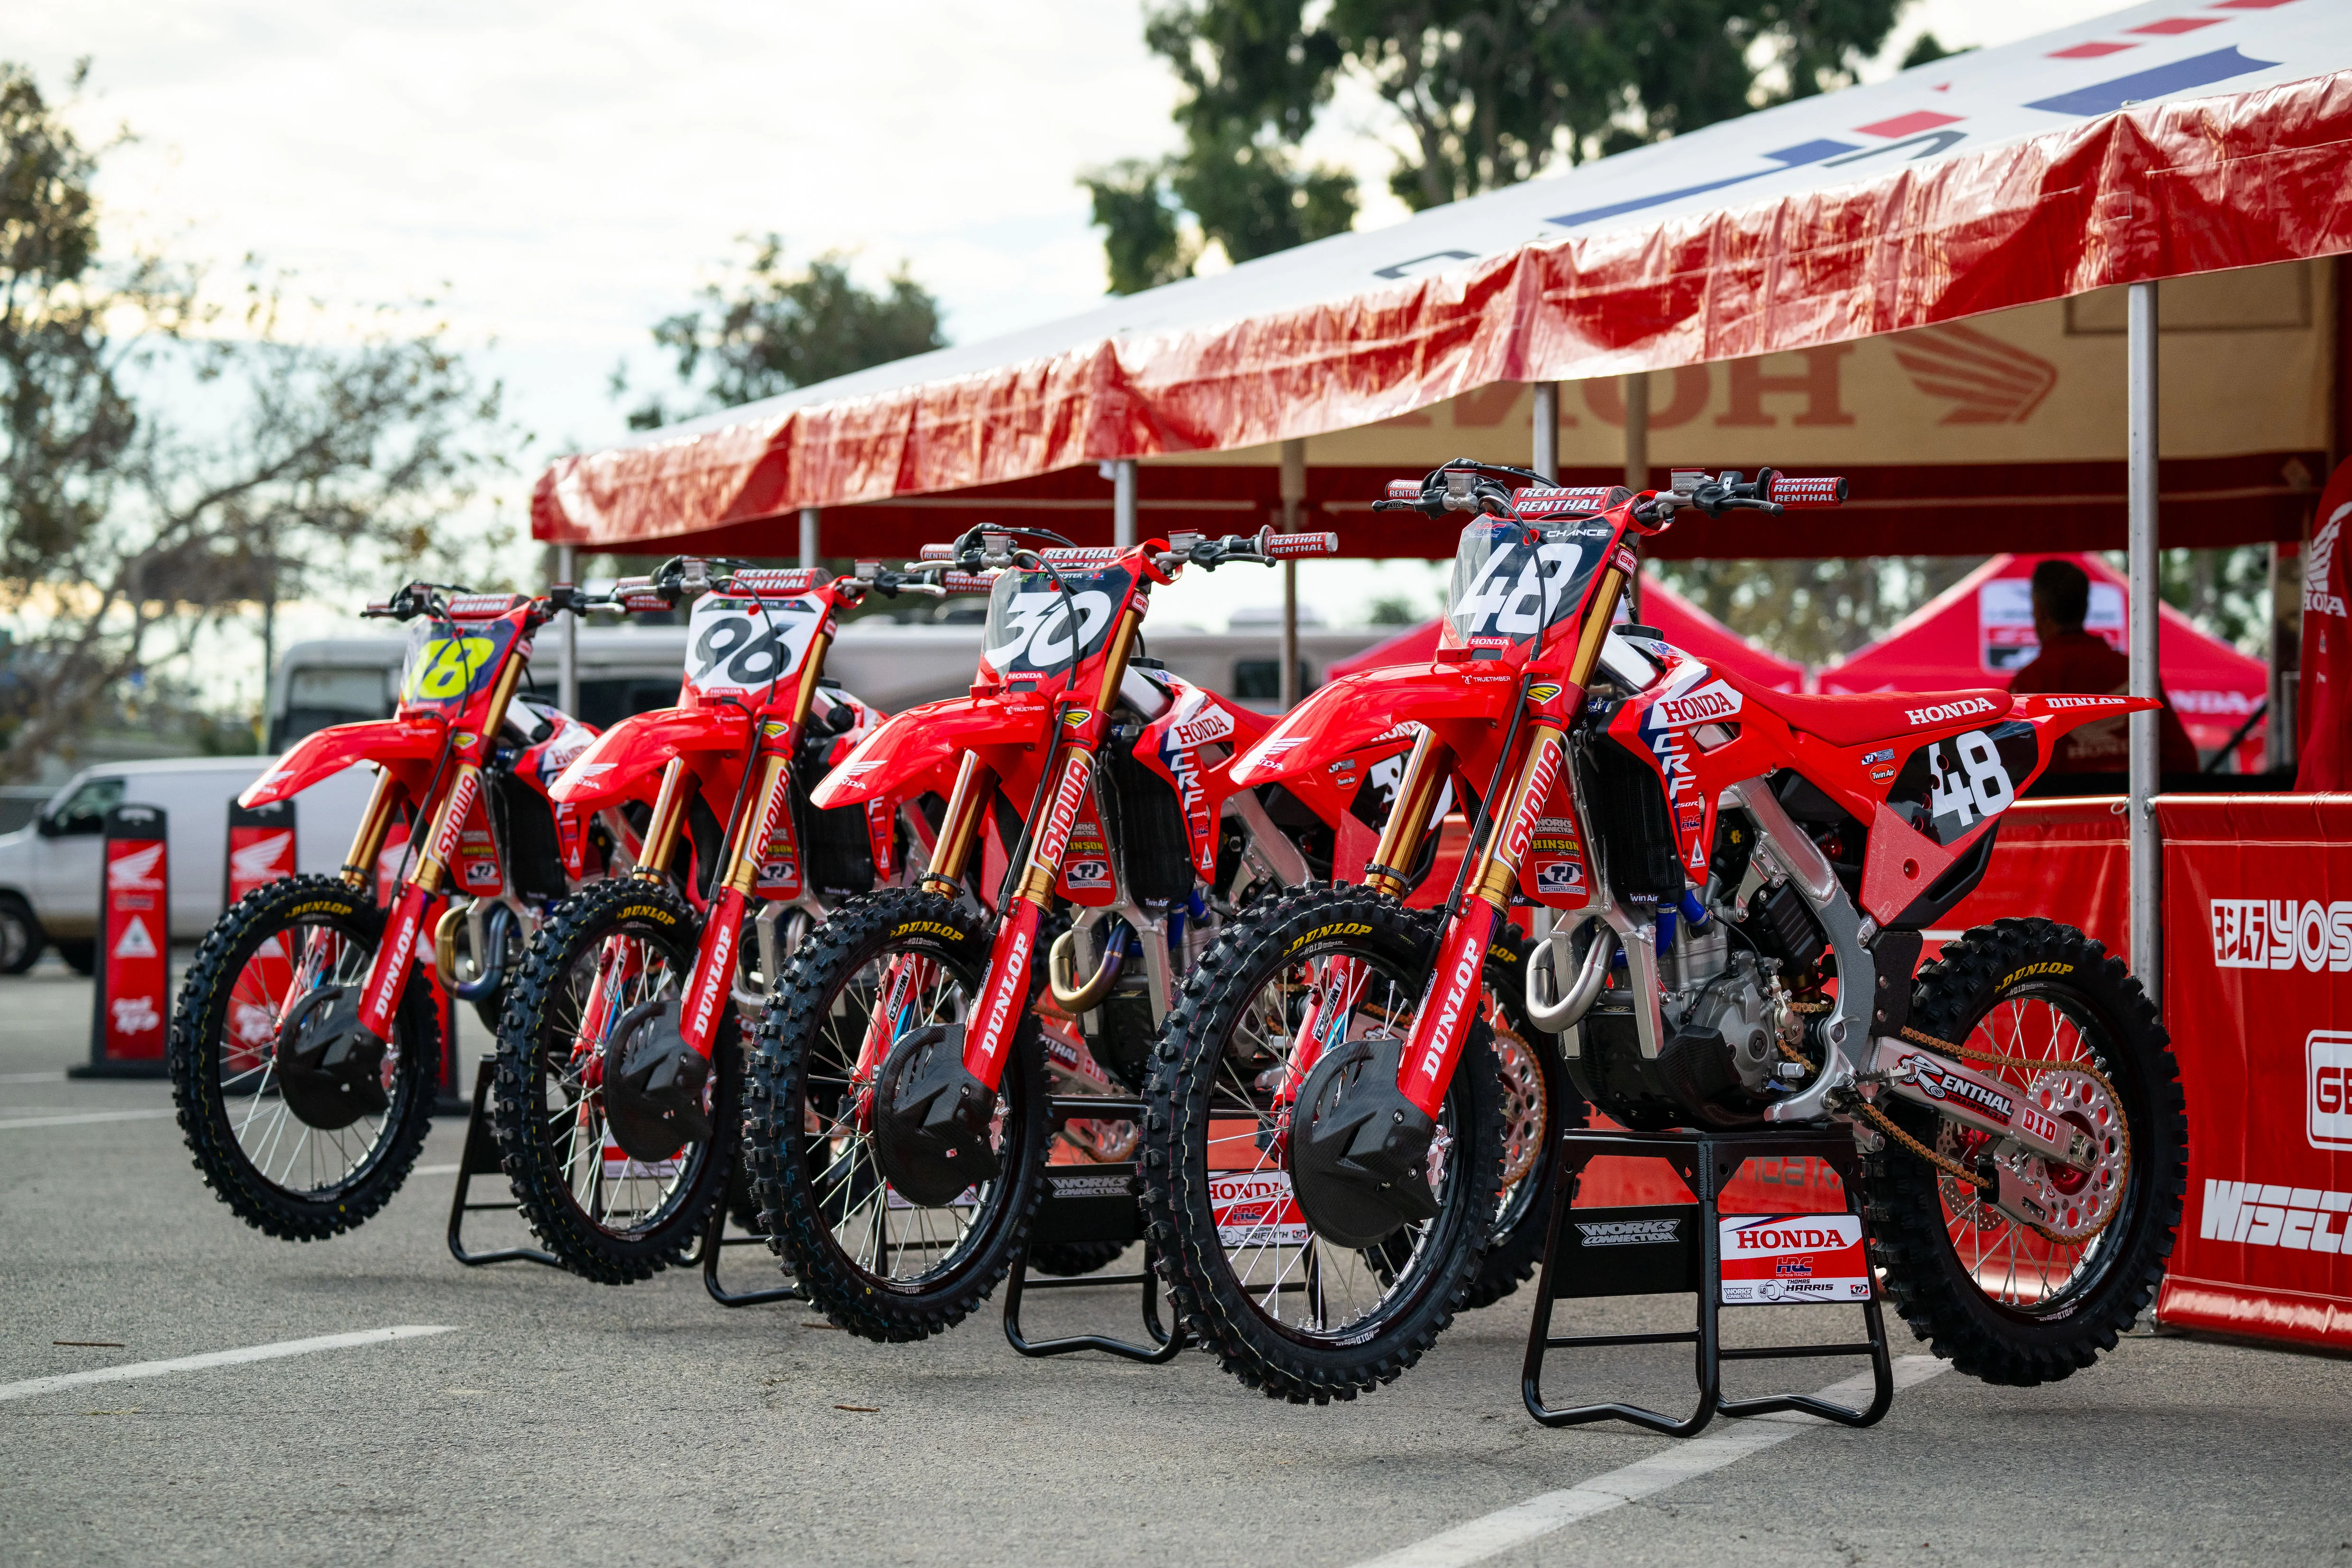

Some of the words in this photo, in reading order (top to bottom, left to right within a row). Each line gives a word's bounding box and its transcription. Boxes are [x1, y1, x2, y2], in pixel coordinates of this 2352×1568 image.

[1520, 487, 1609, 498] RENTHAL
[1516, 499, 1601, 512] RENTHAL
[1270, 535, 1324, 545] RENTHAL
[1546, 529, 1608, 538] CHANCE
[1043, 548, 1119, 559] RENTHAL
[1271, 544, 1324, 554] RENTHAL
[737, 568, 809, 577] RENTHAL
[1620, 555, 1636, 571] GET
[733, 578, 806, 590] RENTHAL
[1452, 543, 1582, 634] 48
[983, 590, 1111, 667] 30
[689, 617, 797, 684] 96
[403, 637, 495, 700] 18
[1659, 692, 1736, 723] HONDA
[1905, 697, 1997, 725] HONDA
[1174, 715, 1230, 744] HONDA
[1255, 760, 1284, 771] NDA
[1653, 732, 1697, 800] CRF
[1872, 771, 1886, 779] Twin
[842, 779, 866, 790] NDA
[1170, 752, 1204, 811] CRF
[1928, 730, 2015, 826] 48
[1506, 738, 1564, 866] SHOWA
[439, 773, 476, 862] SHOWA
[1039, 758, 1090, 869] SHOWA
[1068, 842, 1103, 851] INSON
[1532, 839, 1579, 851] HINSON
[1145, 898, 1157, 907] Twin
[1630, 893, 1643, 902] Twin
[292, 900, 352, 917] DUNLOP
[621, 905, 676, 926] DUNLOP
[895, 920, 964, 941] DUNLOP
[1289, 923, 1373, 954] DUNLOP
[375, 916, 416, 1021] DUNLOP
[2000, 962, 2074, 990] DUNLOP
[694, 926, 732, 1039] DUNLOP
[981, 933, 1027, 1058] DUNLOP
[1423, 938, 1478, 1082] DUNLOP
[1945, 1093, 2009, 1125] CHAINWHEELS
[1053, 1186, 1131, 1197] CONNECTION
[1054, 1175, 1132, 1188] WORKS
[1210, 1182, 1289, 1200] HONDA
[1583, 1220, 1678, 1236] WORKS
[1583, 1232, 1675, 1244] CONNECTION
[1736, 1229, 1847, 1249] HONDA
